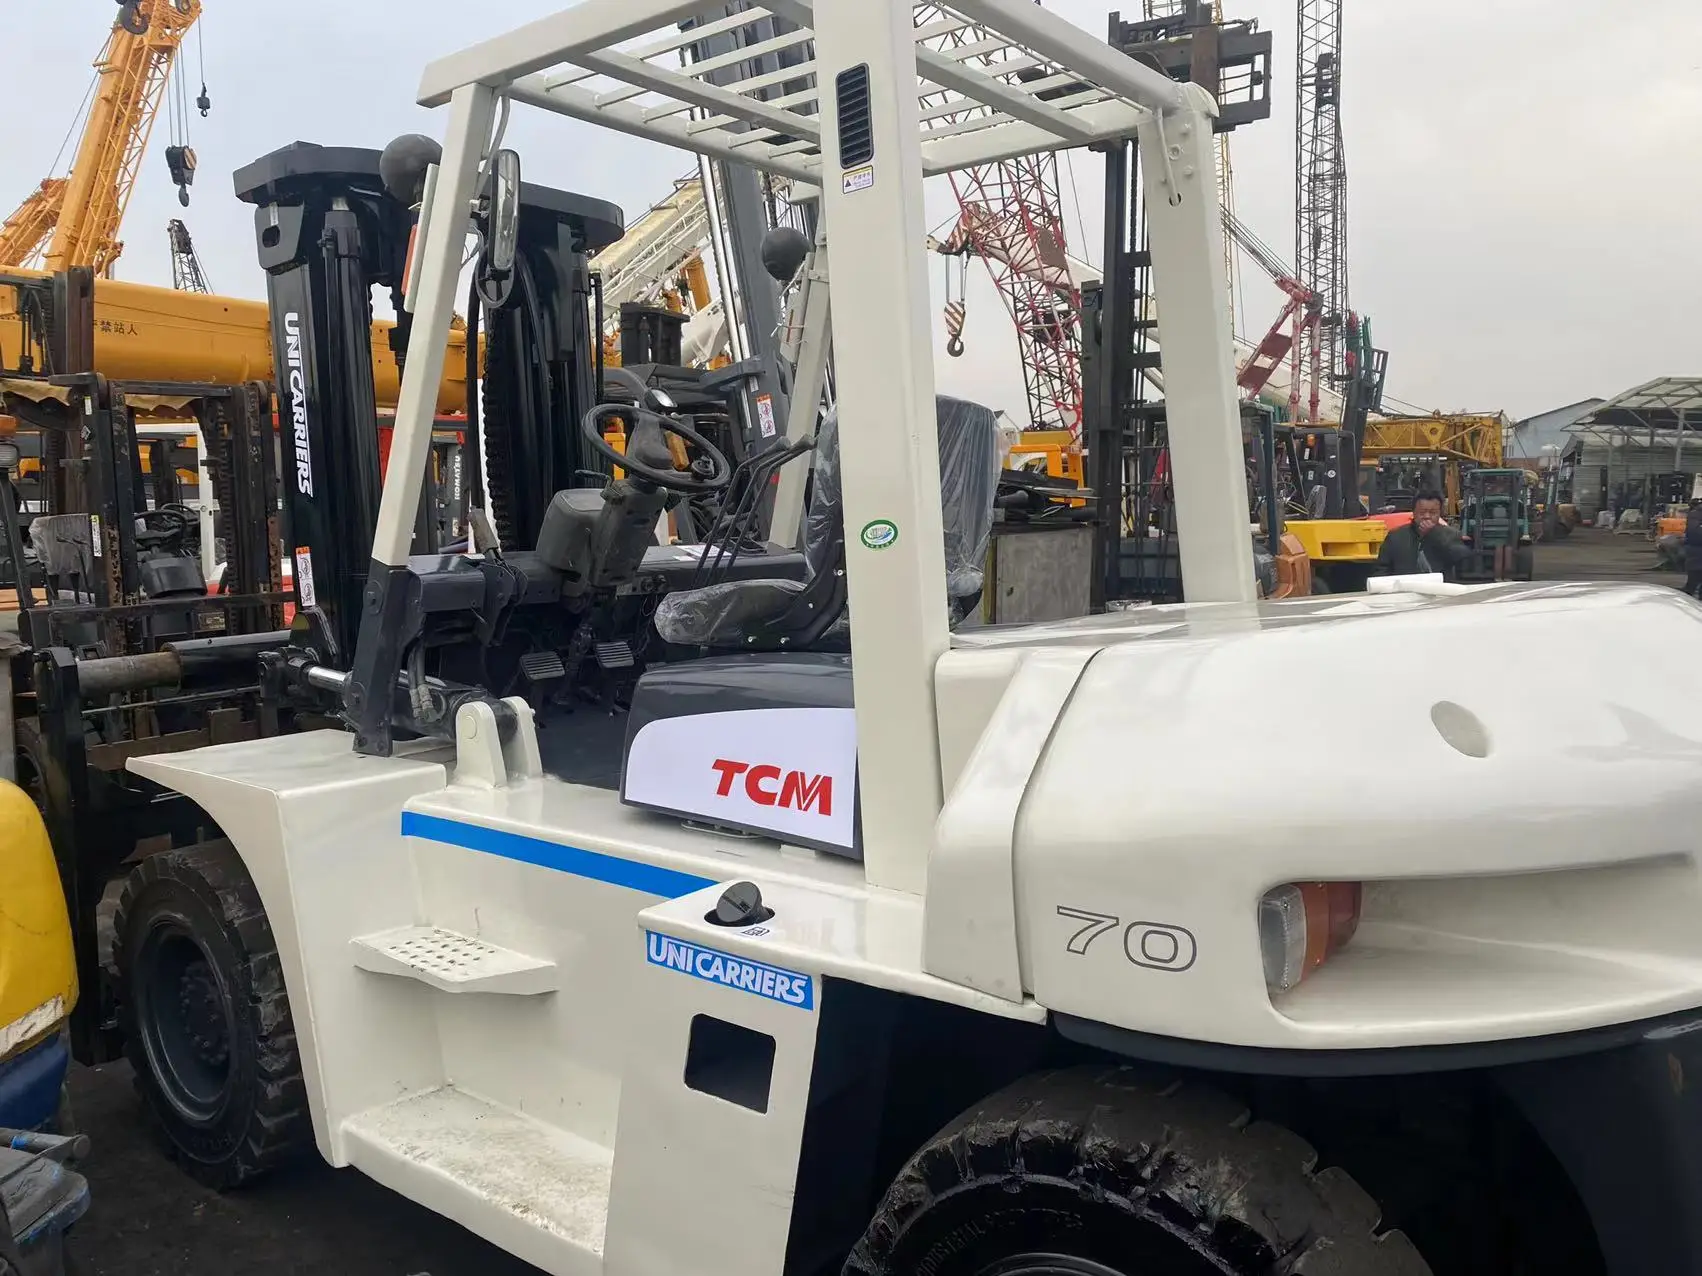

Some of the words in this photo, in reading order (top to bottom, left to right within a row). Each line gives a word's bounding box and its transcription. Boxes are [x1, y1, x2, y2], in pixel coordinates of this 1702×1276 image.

[284, 312, 313, 497] UNICARRIERS
[712, 759, 833, 816] TCM
[650, 933, 808, 1004] UNICARRIERS
[1057, 905, 1198, 972] 70
